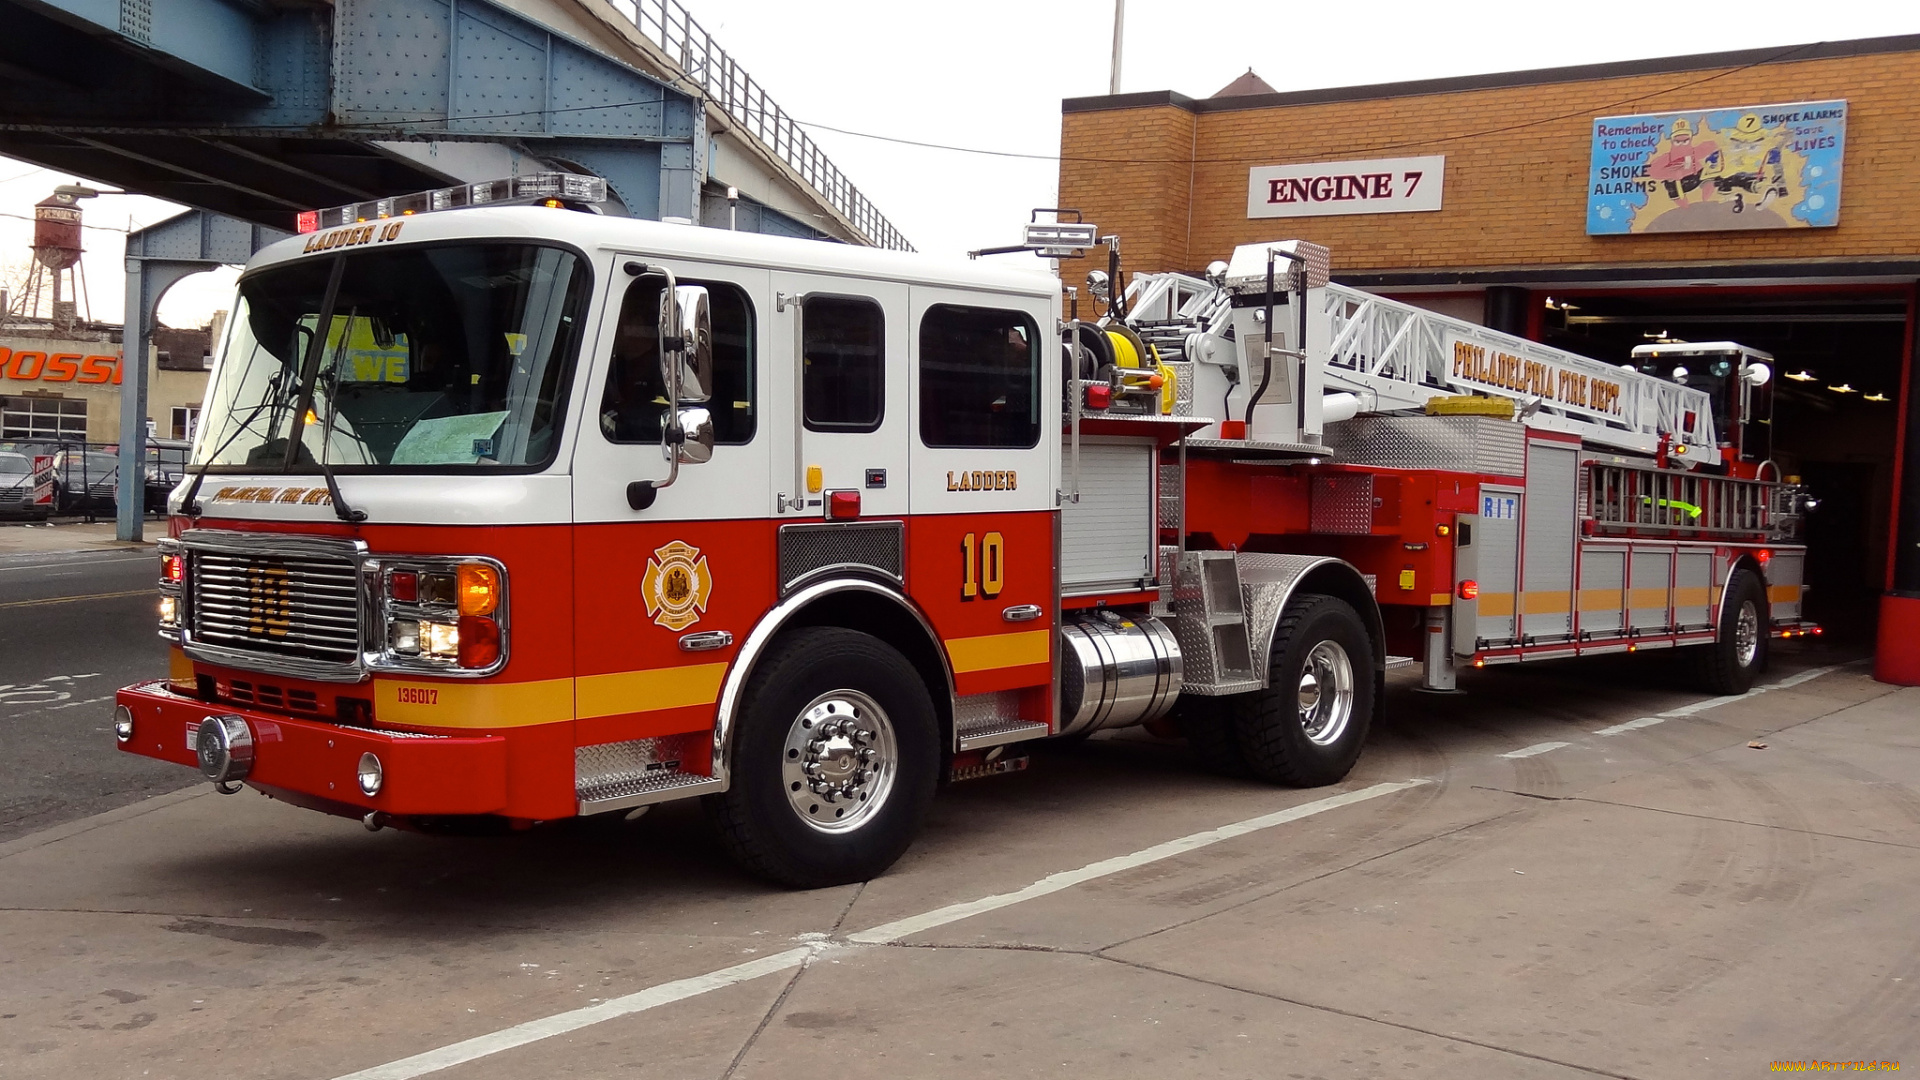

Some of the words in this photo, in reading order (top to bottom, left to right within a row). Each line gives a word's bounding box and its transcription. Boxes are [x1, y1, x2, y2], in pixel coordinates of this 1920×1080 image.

[1746, 117, 1755, 128] 7
[1763, 113, 1800, 124] SMOKE
[1803, 109, 1843, 121] ALARMS
[1598, 122, 1664, 137] Remember
[1675, 121, 1685, 129] 10
[1602, 139, 1616, 150] to
[1620, 136, 1656, 147] check
[1794, 136, 1835, 151] LIVES
[1611, 151, 1643, 166] your
[1600, 164, 1652, 179] SMOKE
[1267, 173, 1393, 204] ENGINE
[1404, 171, 1423, 198] 7
[1594, 180, 1656, 195] ALARMS
[303, 225, 377, 254] LADDER
[378, 221, 404, 243] 10
[1453, 340, 1554, 400] PHILADELPHIA
[1558, 369, 1588, 407] FIRE
[1590, 377, 1622, 416] DEPT.
[947, 471, 1017, 491] LADDER
[960, 531, 1004, 603] 10
[398, 687, 438, 705] 136017
